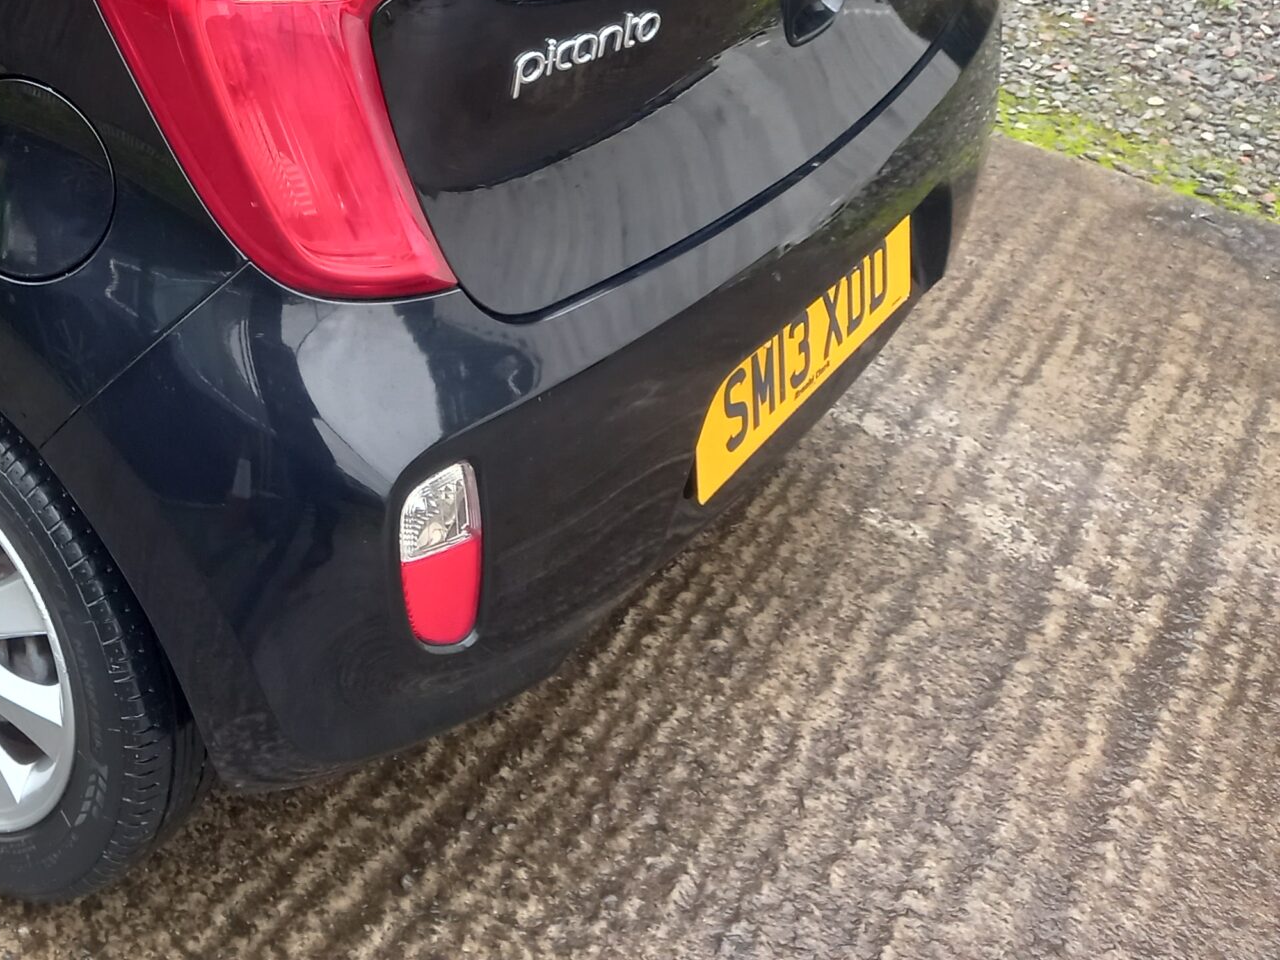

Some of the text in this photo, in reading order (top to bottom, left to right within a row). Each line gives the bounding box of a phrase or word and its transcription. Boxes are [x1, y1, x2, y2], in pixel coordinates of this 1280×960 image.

[510, 9, 661, 100] picanto
[723, 240, 889, 453] SM13 XDD
